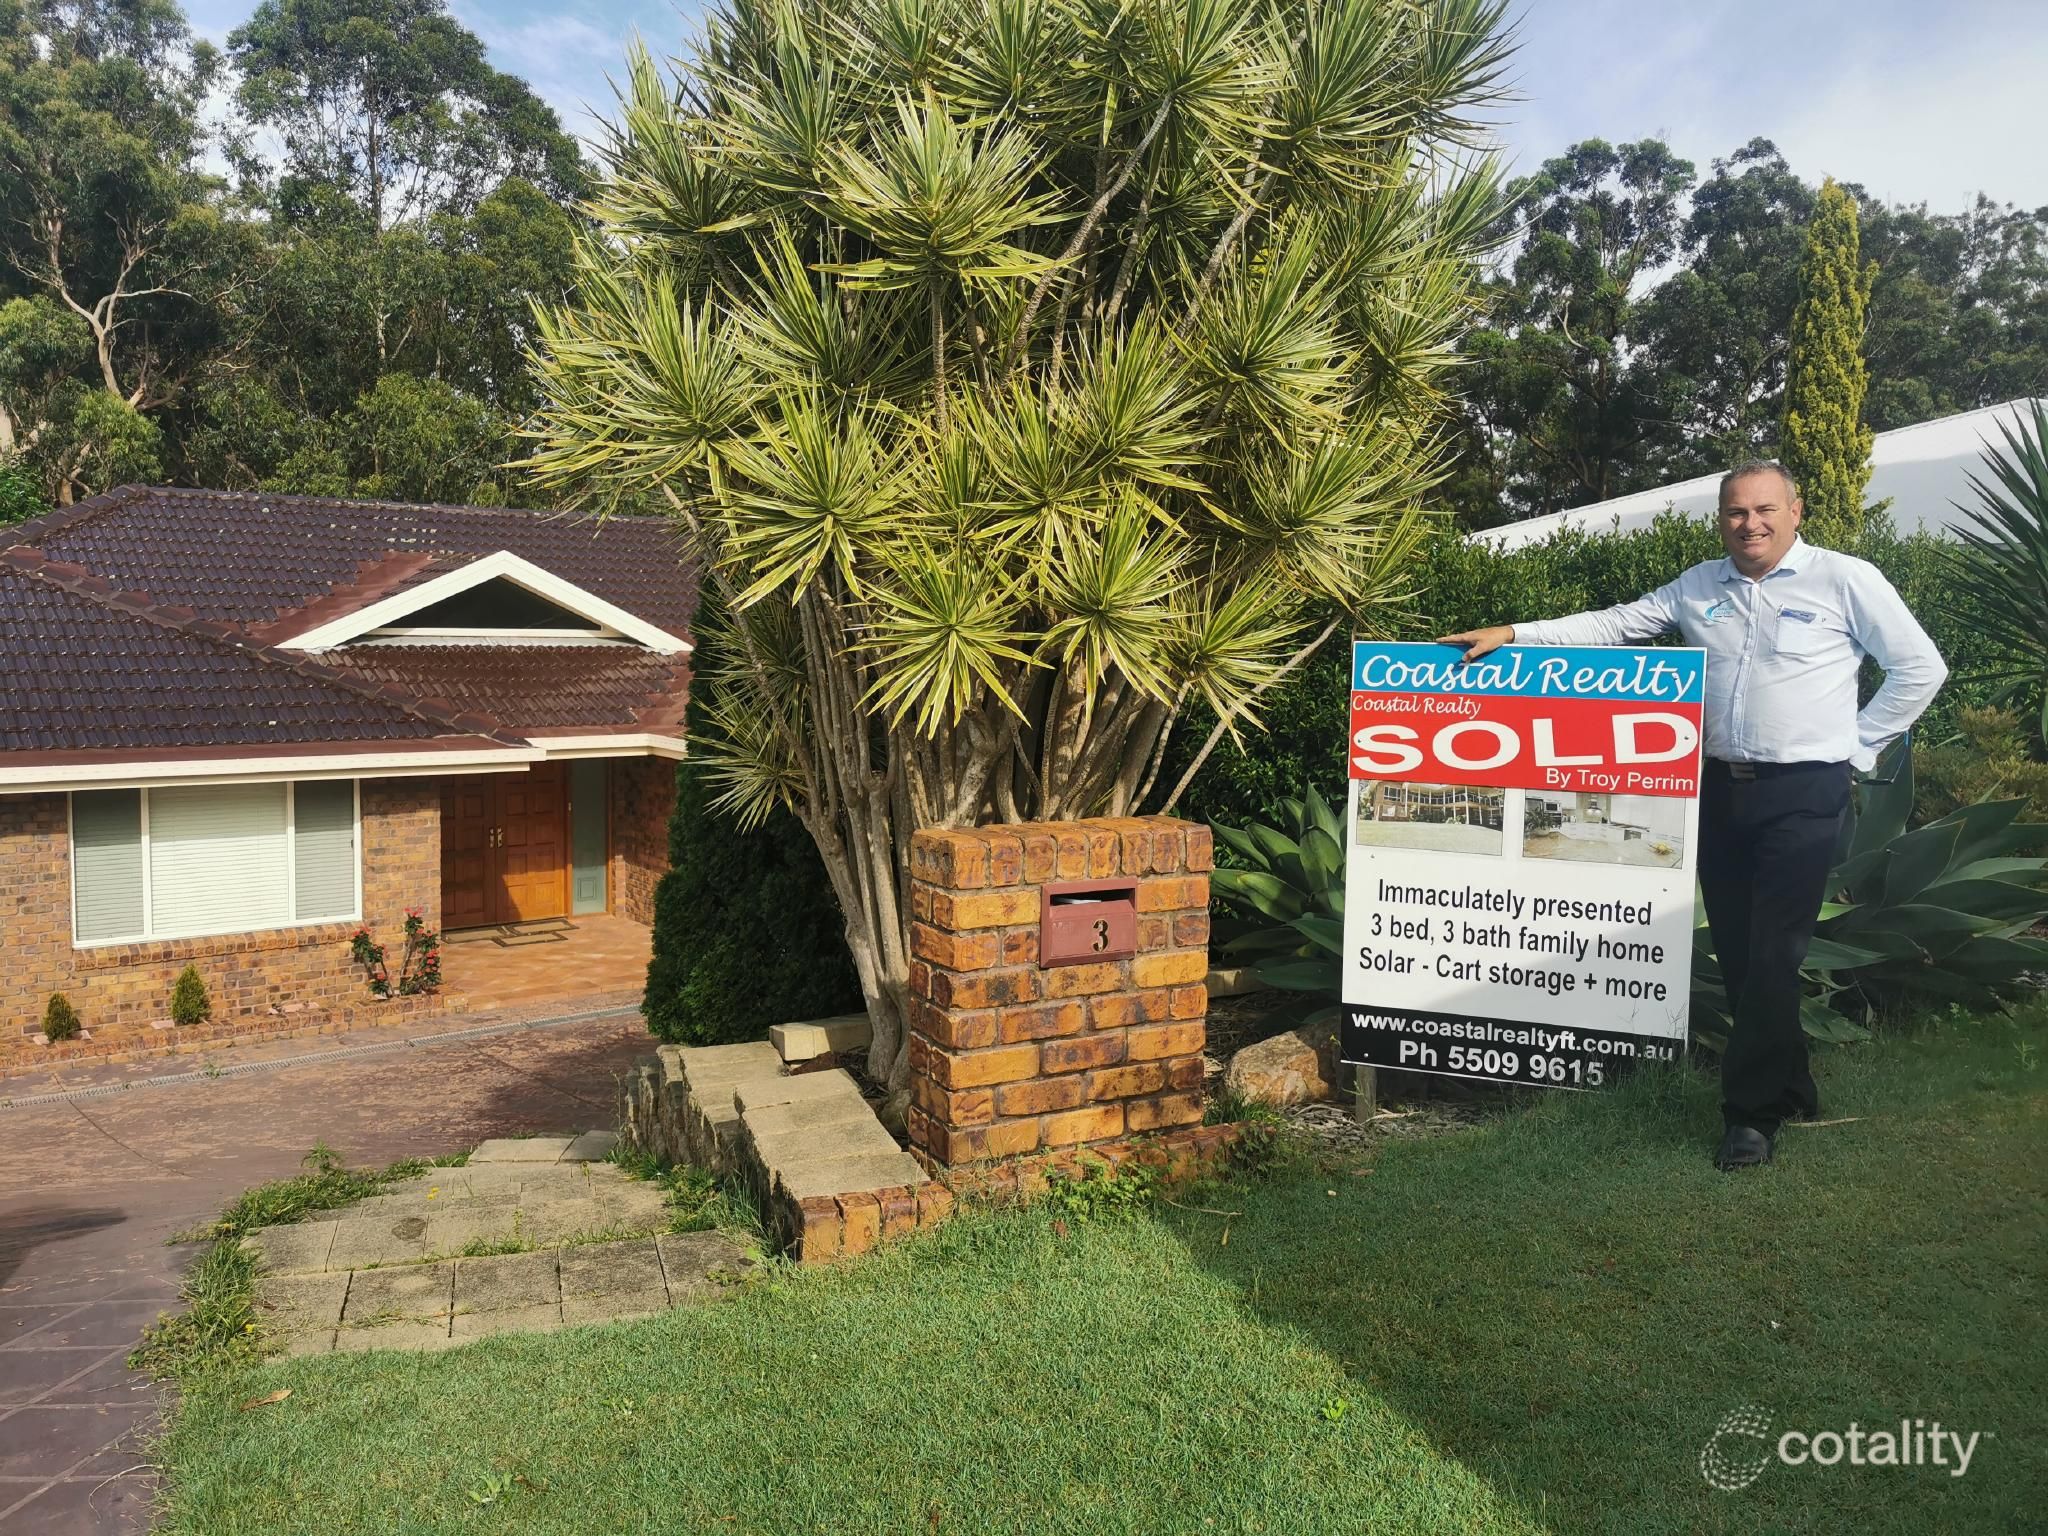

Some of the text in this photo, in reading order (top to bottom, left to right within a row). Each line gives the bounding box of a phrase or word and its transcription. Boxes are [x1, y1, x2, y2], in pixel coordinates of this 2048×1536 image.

[1361, 652, 1696, 703] Coastal Realty
[1352, 694, 1482, 720] Coastal Realty
[1351, 712, 1699, 774] SOLD
[1546, 767, 1694, 791] By Troy Perrim
[1378, 878, 1653, 926] Immaculately presented
[1092, 919, 1109, 953] 3
[1370, 912, 1665, 964] 3 bed, 3 bath family home
[1359, 947, 1416, 974] Solar
[1436, 954, 1482, 982] Cart
[1488, 962, 1576, 996] storage
[1583, 973, 1598, 990] +
[1605, 977, 1668, 1002] more
[1351, 1012, 1673, 1062] www.coastalrealtyft.com.au
[1399, 1040, 1604, 1086] Ph 5509 9615
